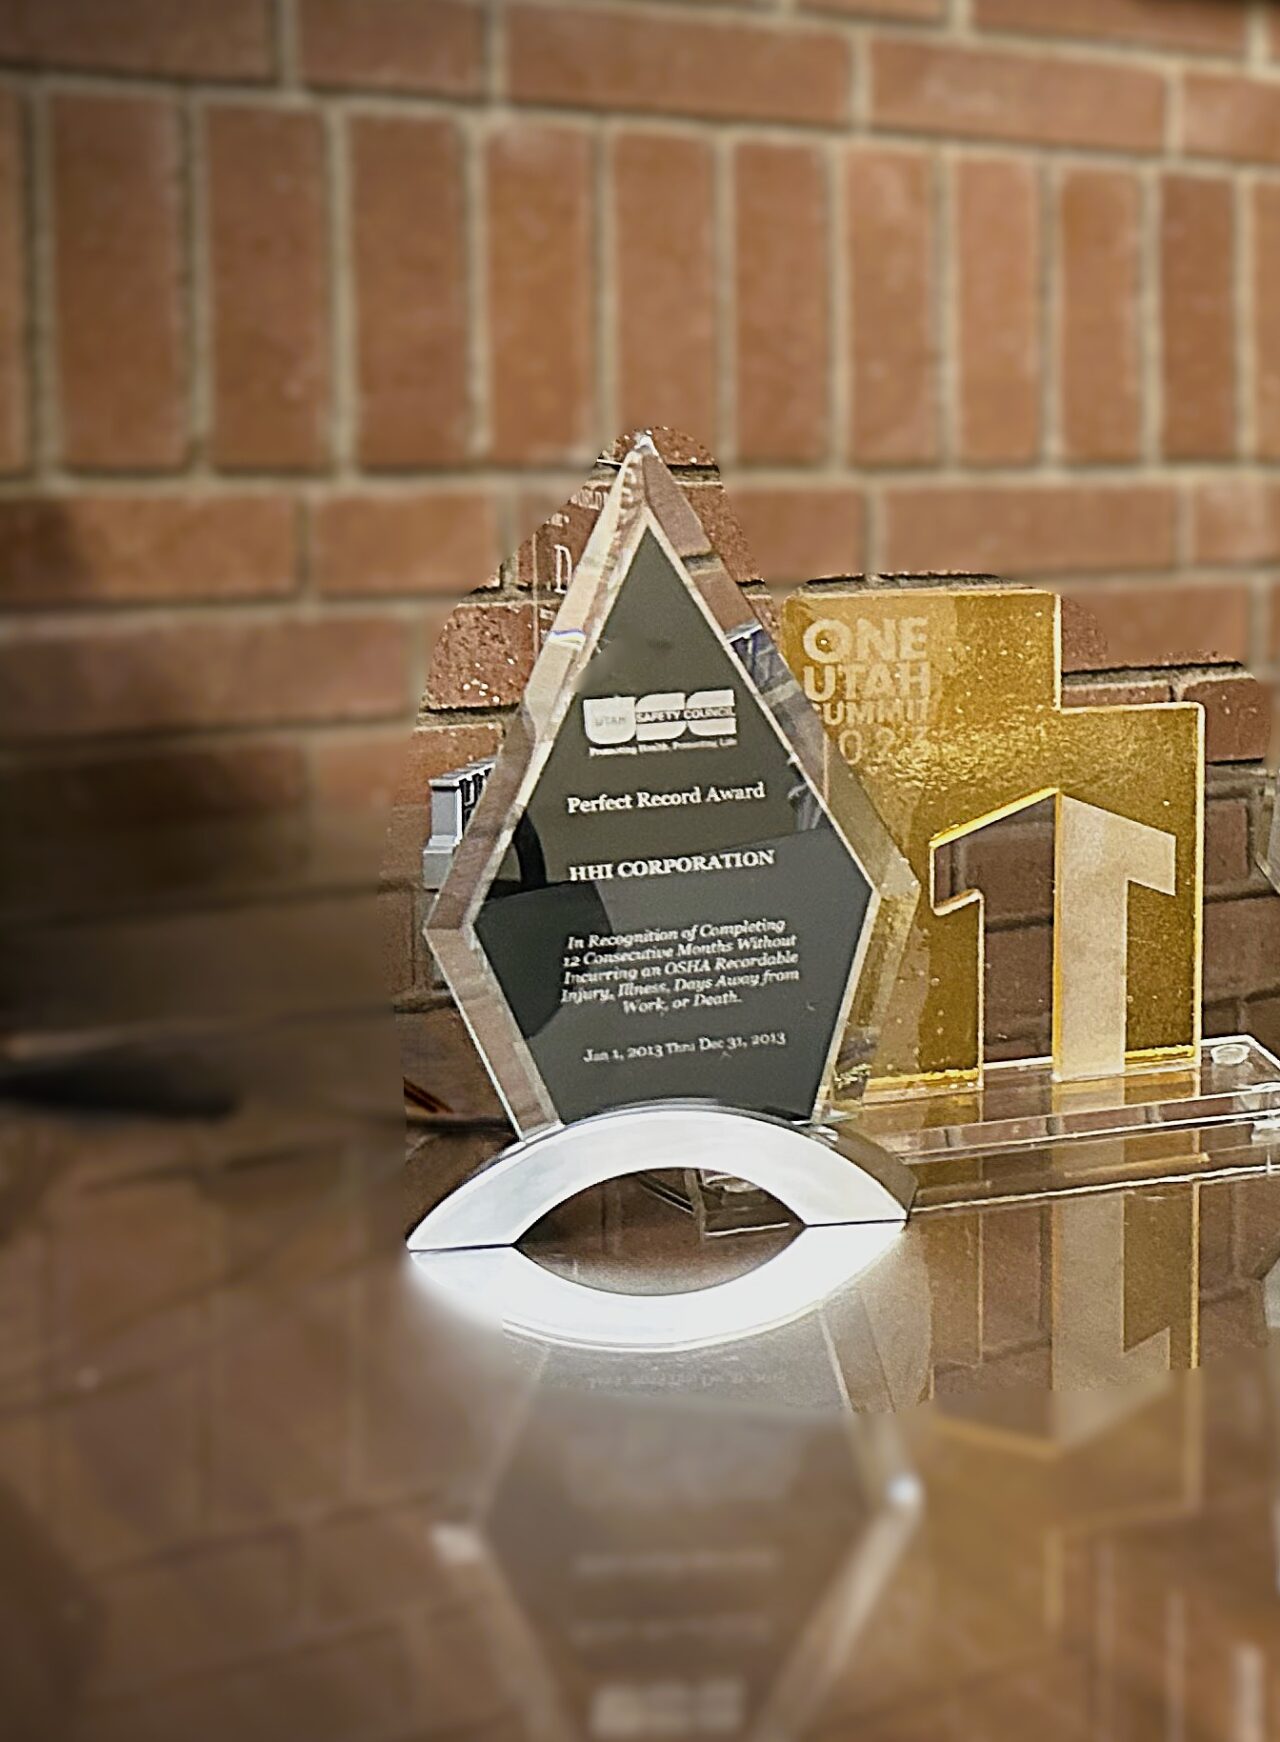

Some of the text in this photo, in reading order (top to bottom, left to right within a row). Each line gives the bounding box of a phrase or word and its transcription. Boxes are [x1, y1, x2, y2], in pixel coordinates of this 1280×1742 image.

[803, 617, 928, 663] ONE
[803, 661, 931, 702] UTAH
[636, 709, 681, 723] SAFETY
[812, 698, 929, 725] UMMIT
[568, 781, 766, 814] Perfect Record Award
[570, 849, 775, 882] HHI CORPORATION
[568, 918, 786, 950] In Recognition of Completing
[563, 934, 797, 967] 12 Consecutive Months Without
[564, 952, 799, 984] Incurring an OSHA Recordable
[561, 969, 800, 1004] Injury, Illness, Days Away from
[622, 991, 742, 1014] Work, or Death.
[583, 1050, 609, 1063] Jan
[627, 1045, 664, 1058] 2013
[666, 1042, 696, 1054] Thru
[699, 1037, 725, 1050] Dec
[727, 1036, 748, 1048] 31,
[750, 1032, 787, 1046] 2013
